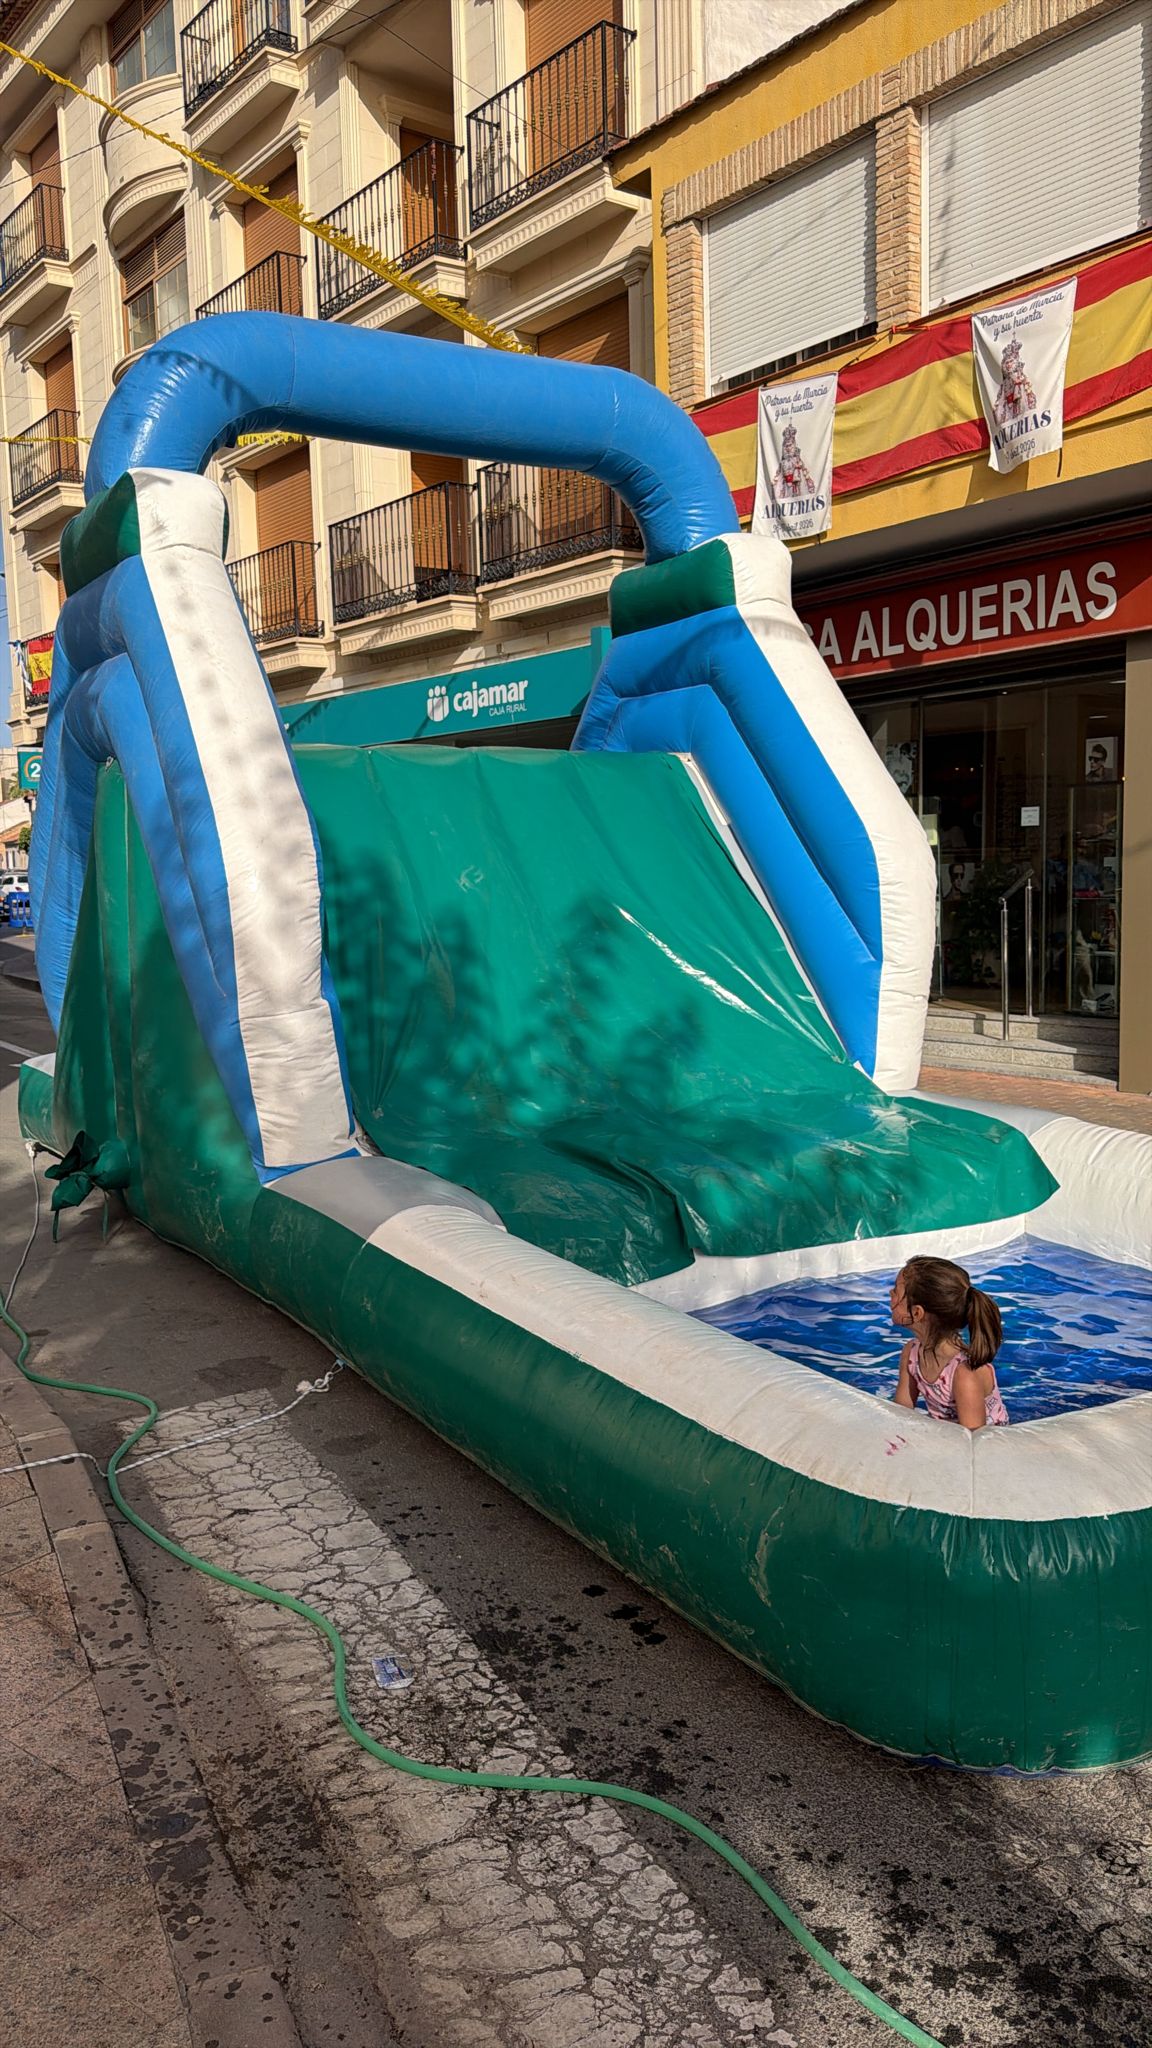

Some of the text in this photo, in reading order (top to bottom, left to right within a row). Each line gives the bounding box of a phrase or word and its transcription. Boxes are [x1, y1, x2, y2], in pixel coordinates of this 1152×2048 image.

[980, 292, 1064, 328] Patrona de Murcia
[993, 309, 1043, 342] y su huerta
[765, 384, 828, 406] Patrona de Murcia
[775, 409, 780, 422] y
[790, 399, 814, 414] huerta
[803, 561, 1118, 665] A ALQUERIAS
[453, 679, 529, 718] cajamar
[489, 702, 527, 716] CAJA RURAL
